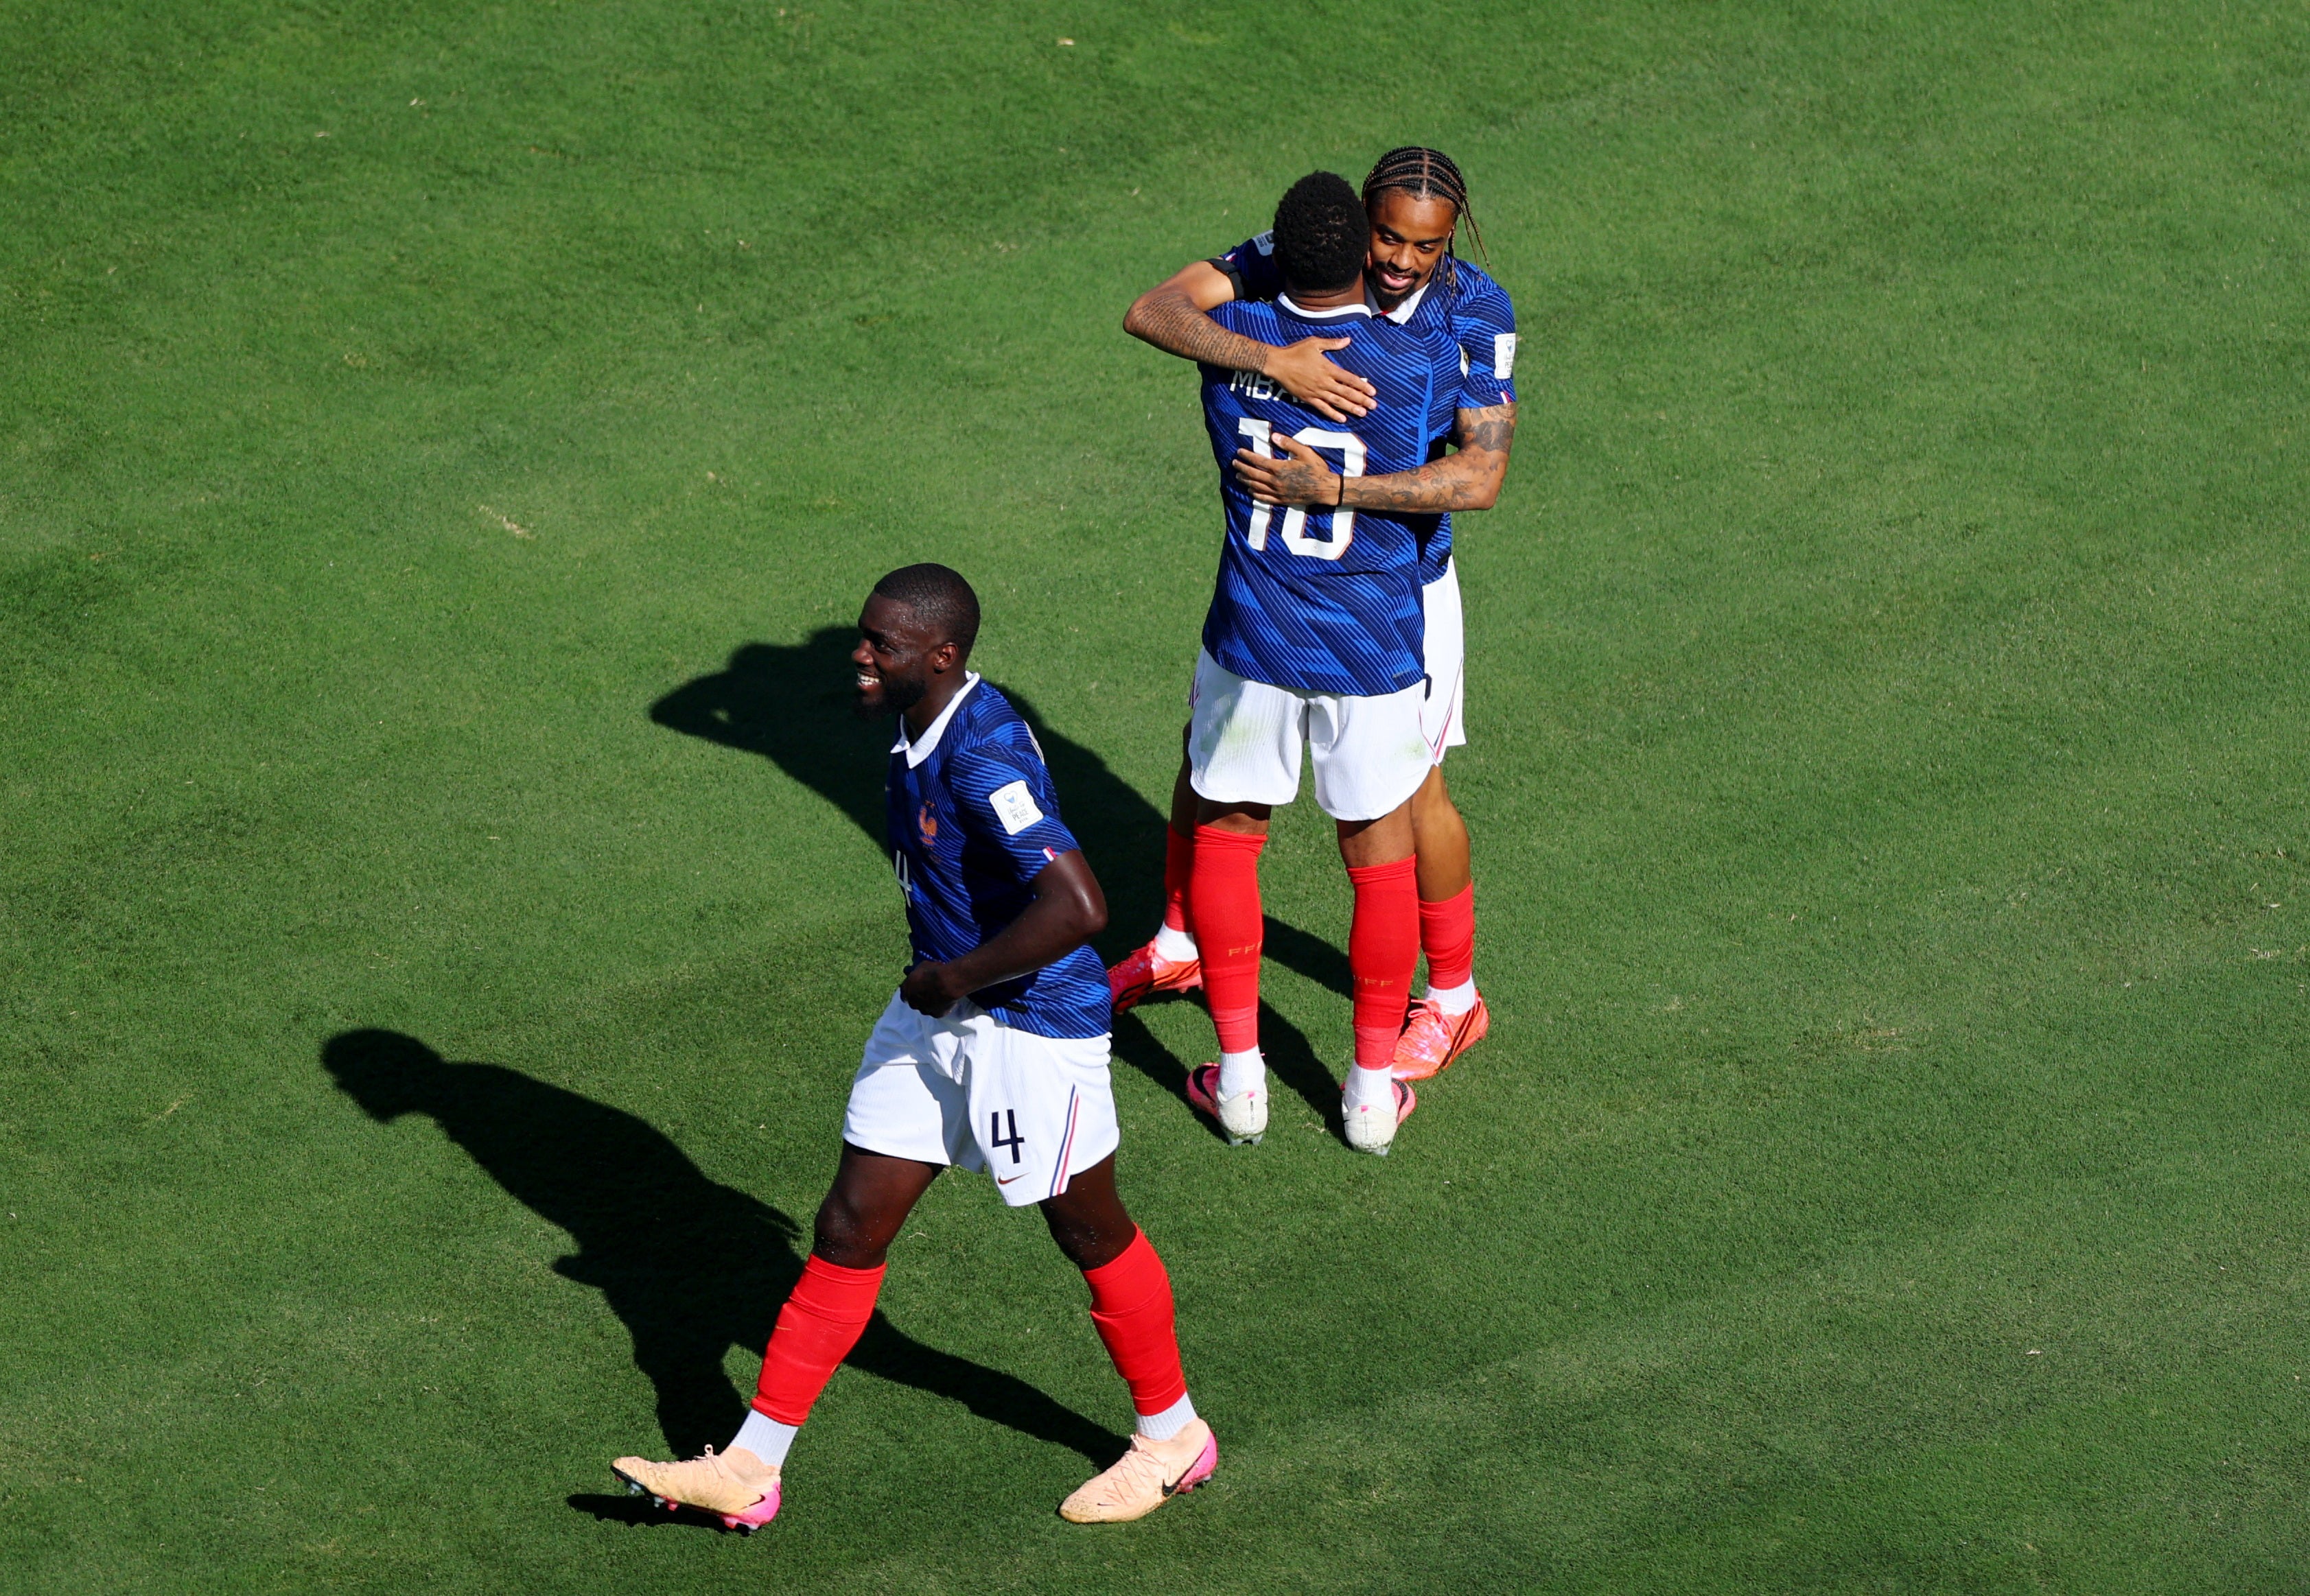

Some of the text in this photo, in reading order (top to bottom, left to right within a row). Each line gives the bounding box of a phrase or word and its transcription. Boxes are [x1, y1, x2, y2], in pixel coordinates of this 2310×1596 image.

[1238, 417, 1368, 560] 10
[895, 850, 913, 908] 4
[1353, 974, 1393, 988] FF
[991, 1109, 1025, 1164] 4
